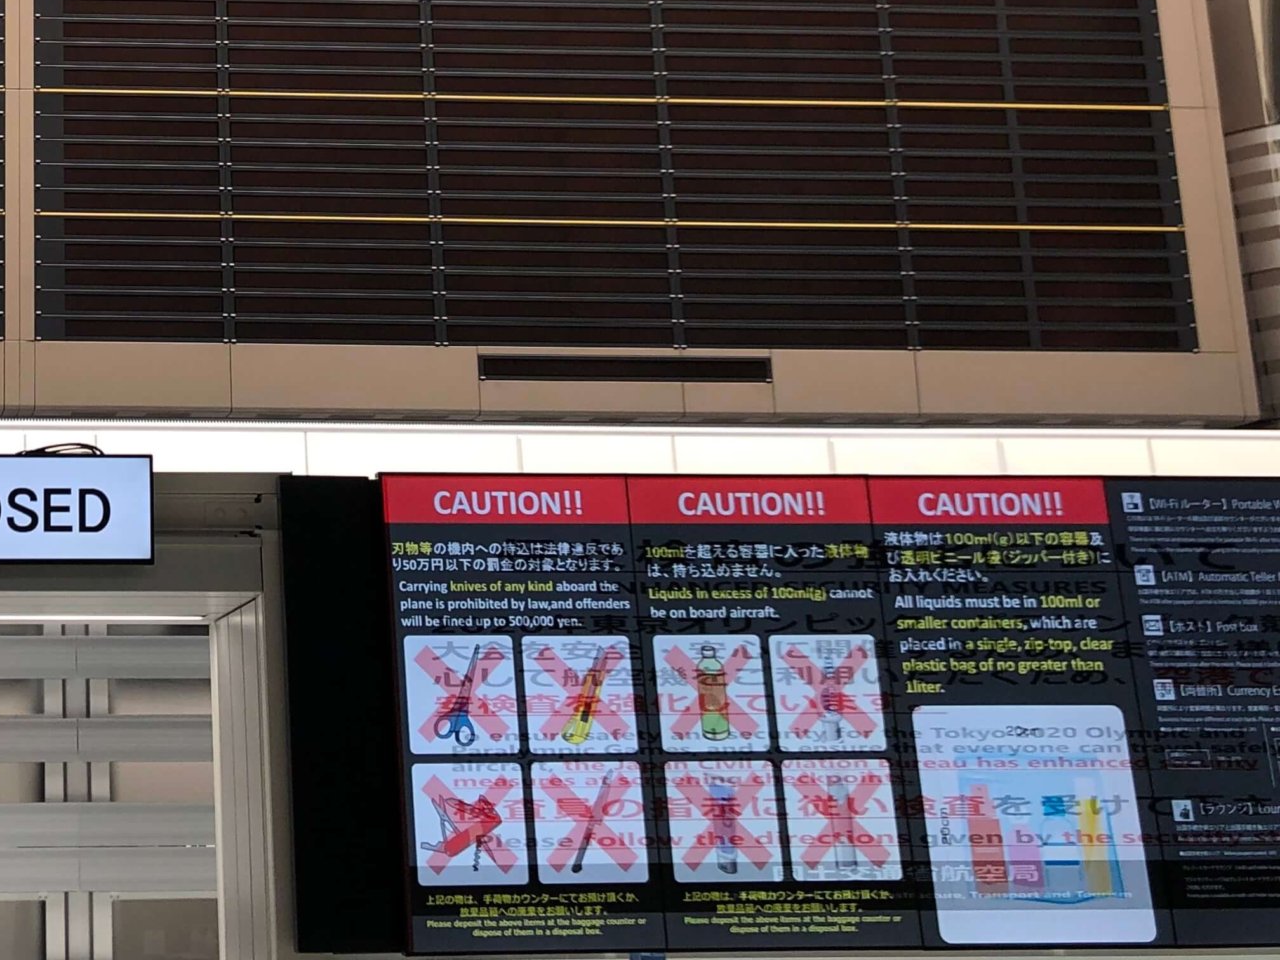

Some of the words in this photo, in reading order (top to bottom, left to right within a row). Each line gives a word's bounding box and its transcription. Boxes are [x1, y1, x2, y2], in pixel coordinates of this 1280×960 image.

[433, 490, 583, 515] CAUTION!!
[678, 491, 826, 517] CAUTION!!
[918, 491, 1064, 517] CAUTION!!
[399, 580, 449, 594] Carrying
[450, 580, 487, 592] knives
[490, 580, 502, 592] of
[504, 582, 525, 595] any
[528, 580, 553, 592] kind
[556, 580, 597, 592] aboard
[599, 581, 619, 592] the
[648, 587, 693, 601] Liquids
[696, 587, 709, 599] in
[711, 590, 752, 599] excess
[754, 587, 768, 599] of
[829, 589, 874, 599] cannot
[400, 598, 433, 612] plane
[435, 598, 445, 610] is
[447, 598, 509, 612] prohibited
[510, 598, 526, 612] by
[575, 597, 631, 610] offenders
[894, 595, 913, 609] All
[916, 595, 962, 611] liquids
[965, 597, 1000, 609] must
[1003, 596, 1020, 609] be
[1023, 596, 1037, 609] in
[1040, 595, 1082, 608] 100ml
[1085, 598, 1101, 608] or
[650, 607, 666, 618] be
[668, 609, 687, 618] on
[689, 607, 727, 618] board
[730, 606, 780, 618] aircraft.
[401, 616, 422, 627] will
[425, 616, 440, 627] be
[442, 615, 472, 627] fined
[475, 618, 491, 630] up
[493, 617, 506, 627] to
[508, 616, 554, 629] 500,000
